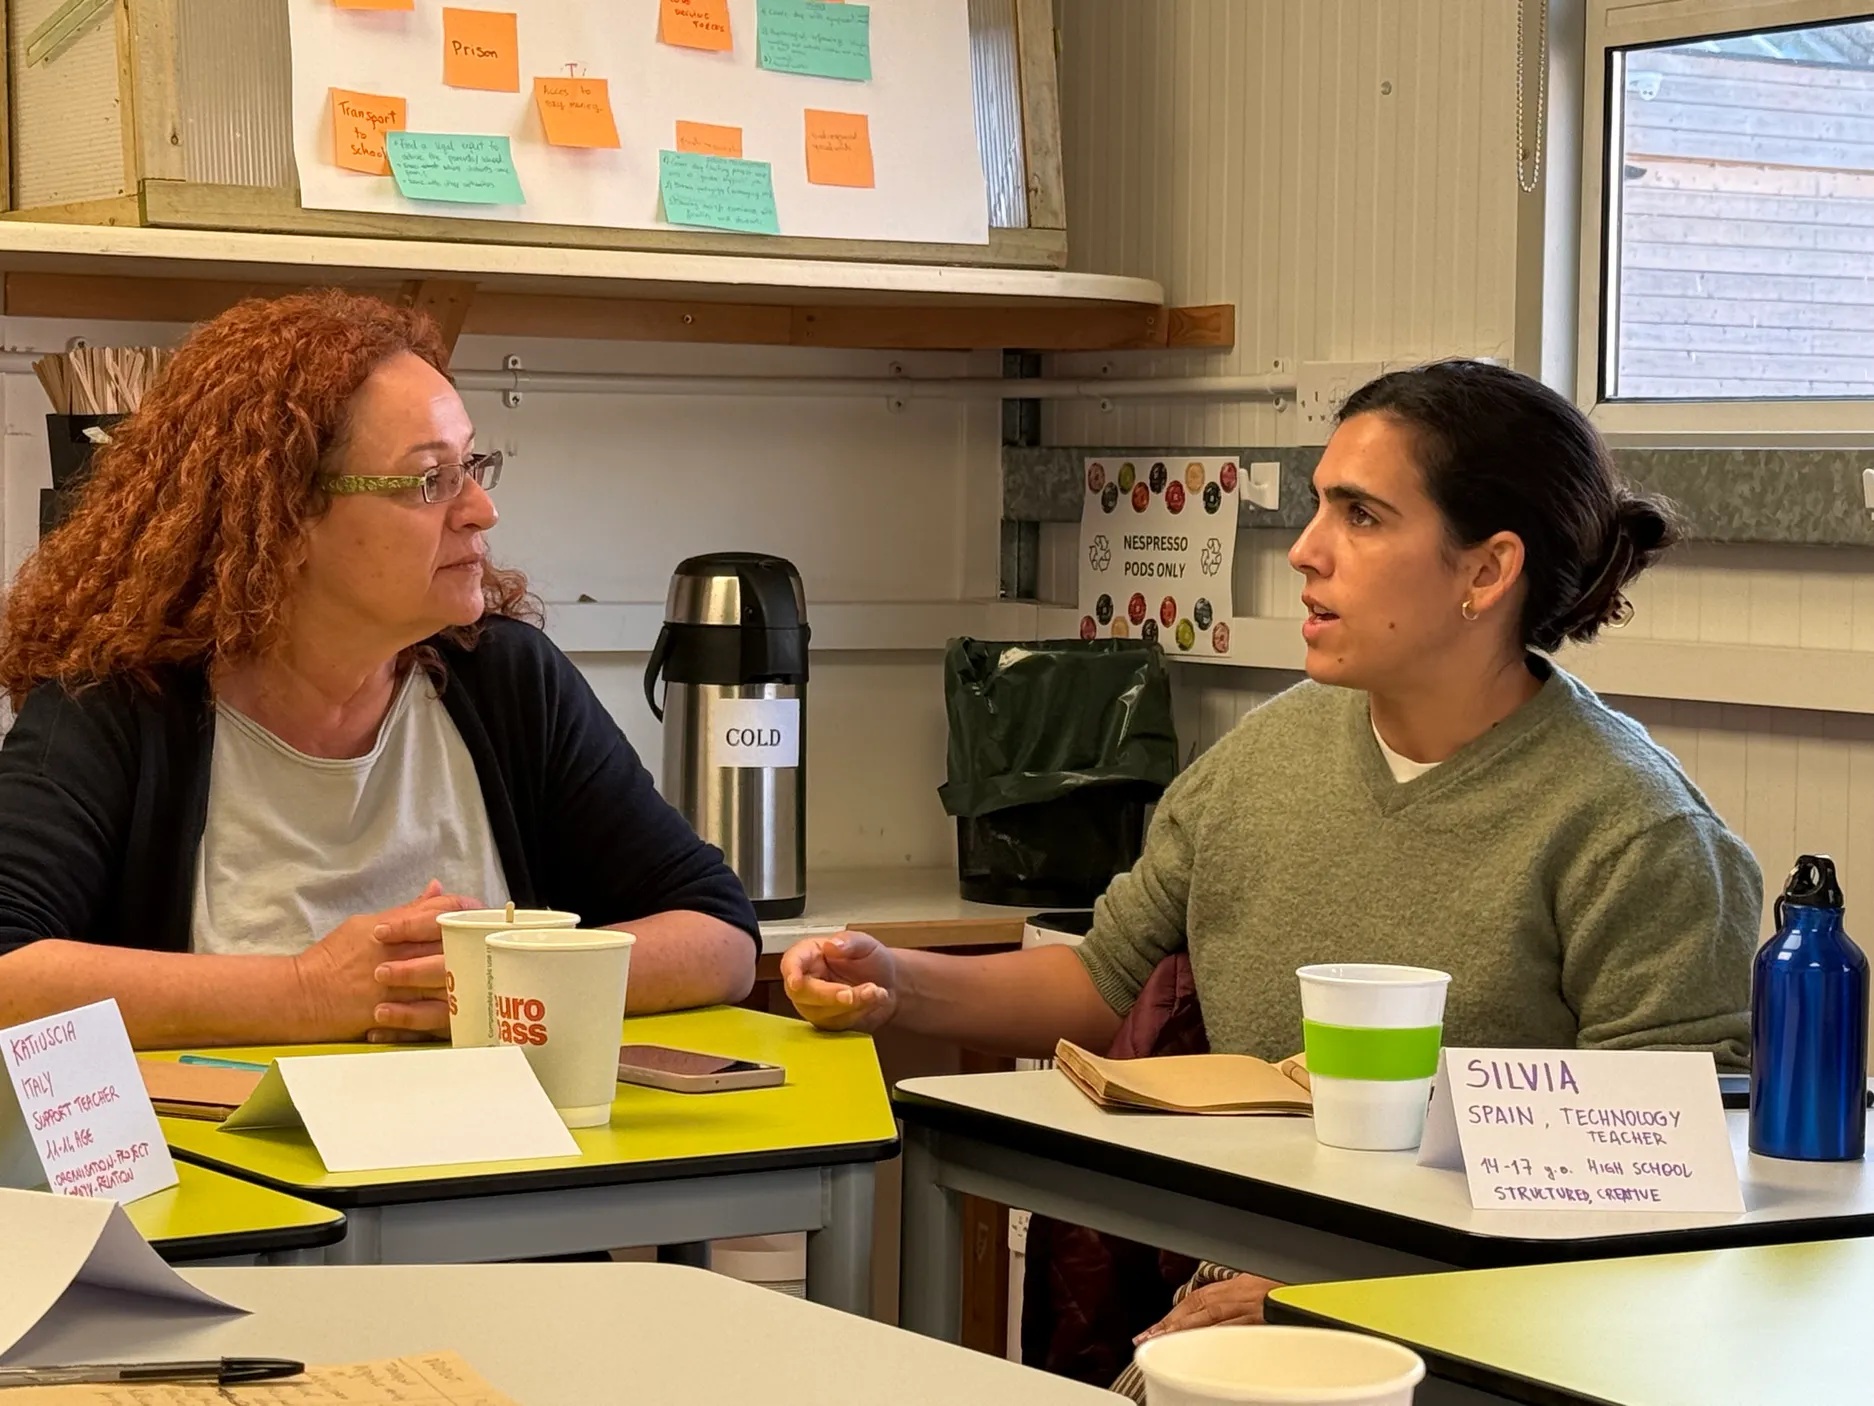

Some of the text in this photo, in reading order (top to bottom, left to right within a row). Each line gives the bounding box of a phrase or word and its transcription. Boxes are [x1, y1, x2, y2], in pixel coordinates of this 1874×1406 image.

[451, 39, 499, 59] Prison
[337, 100, 397, 131] Transport
[352, 126, 368, 140] to
[1123, 535, 1189, 552] NESPRESSO
[1124, 560, 1186, 579] PODS ONLY
[726, 727, 781, 748] COLD
[494, 994, 546, 1022] uro
[497, 1018, 549, 1046] ass
[10, 1019, 77, 1068] KATIUSCIA
[20, 1071, 55, 1100] ITALY
[1465, 1058, 1580, 1095] SILVIA
[32, 1084, 120, 1131] SUPPORT TEACHER
[1559, 1106, 1681, 1128] TECHNOLOGY
[73, 1127, 94, 1149] AGE
[1586, 1129, 1668, 1146] TEACHER
[1632, 1160, 1693, 1179] SCHOOL
[1596, 1187, 1662, 1203] CREATIVE
